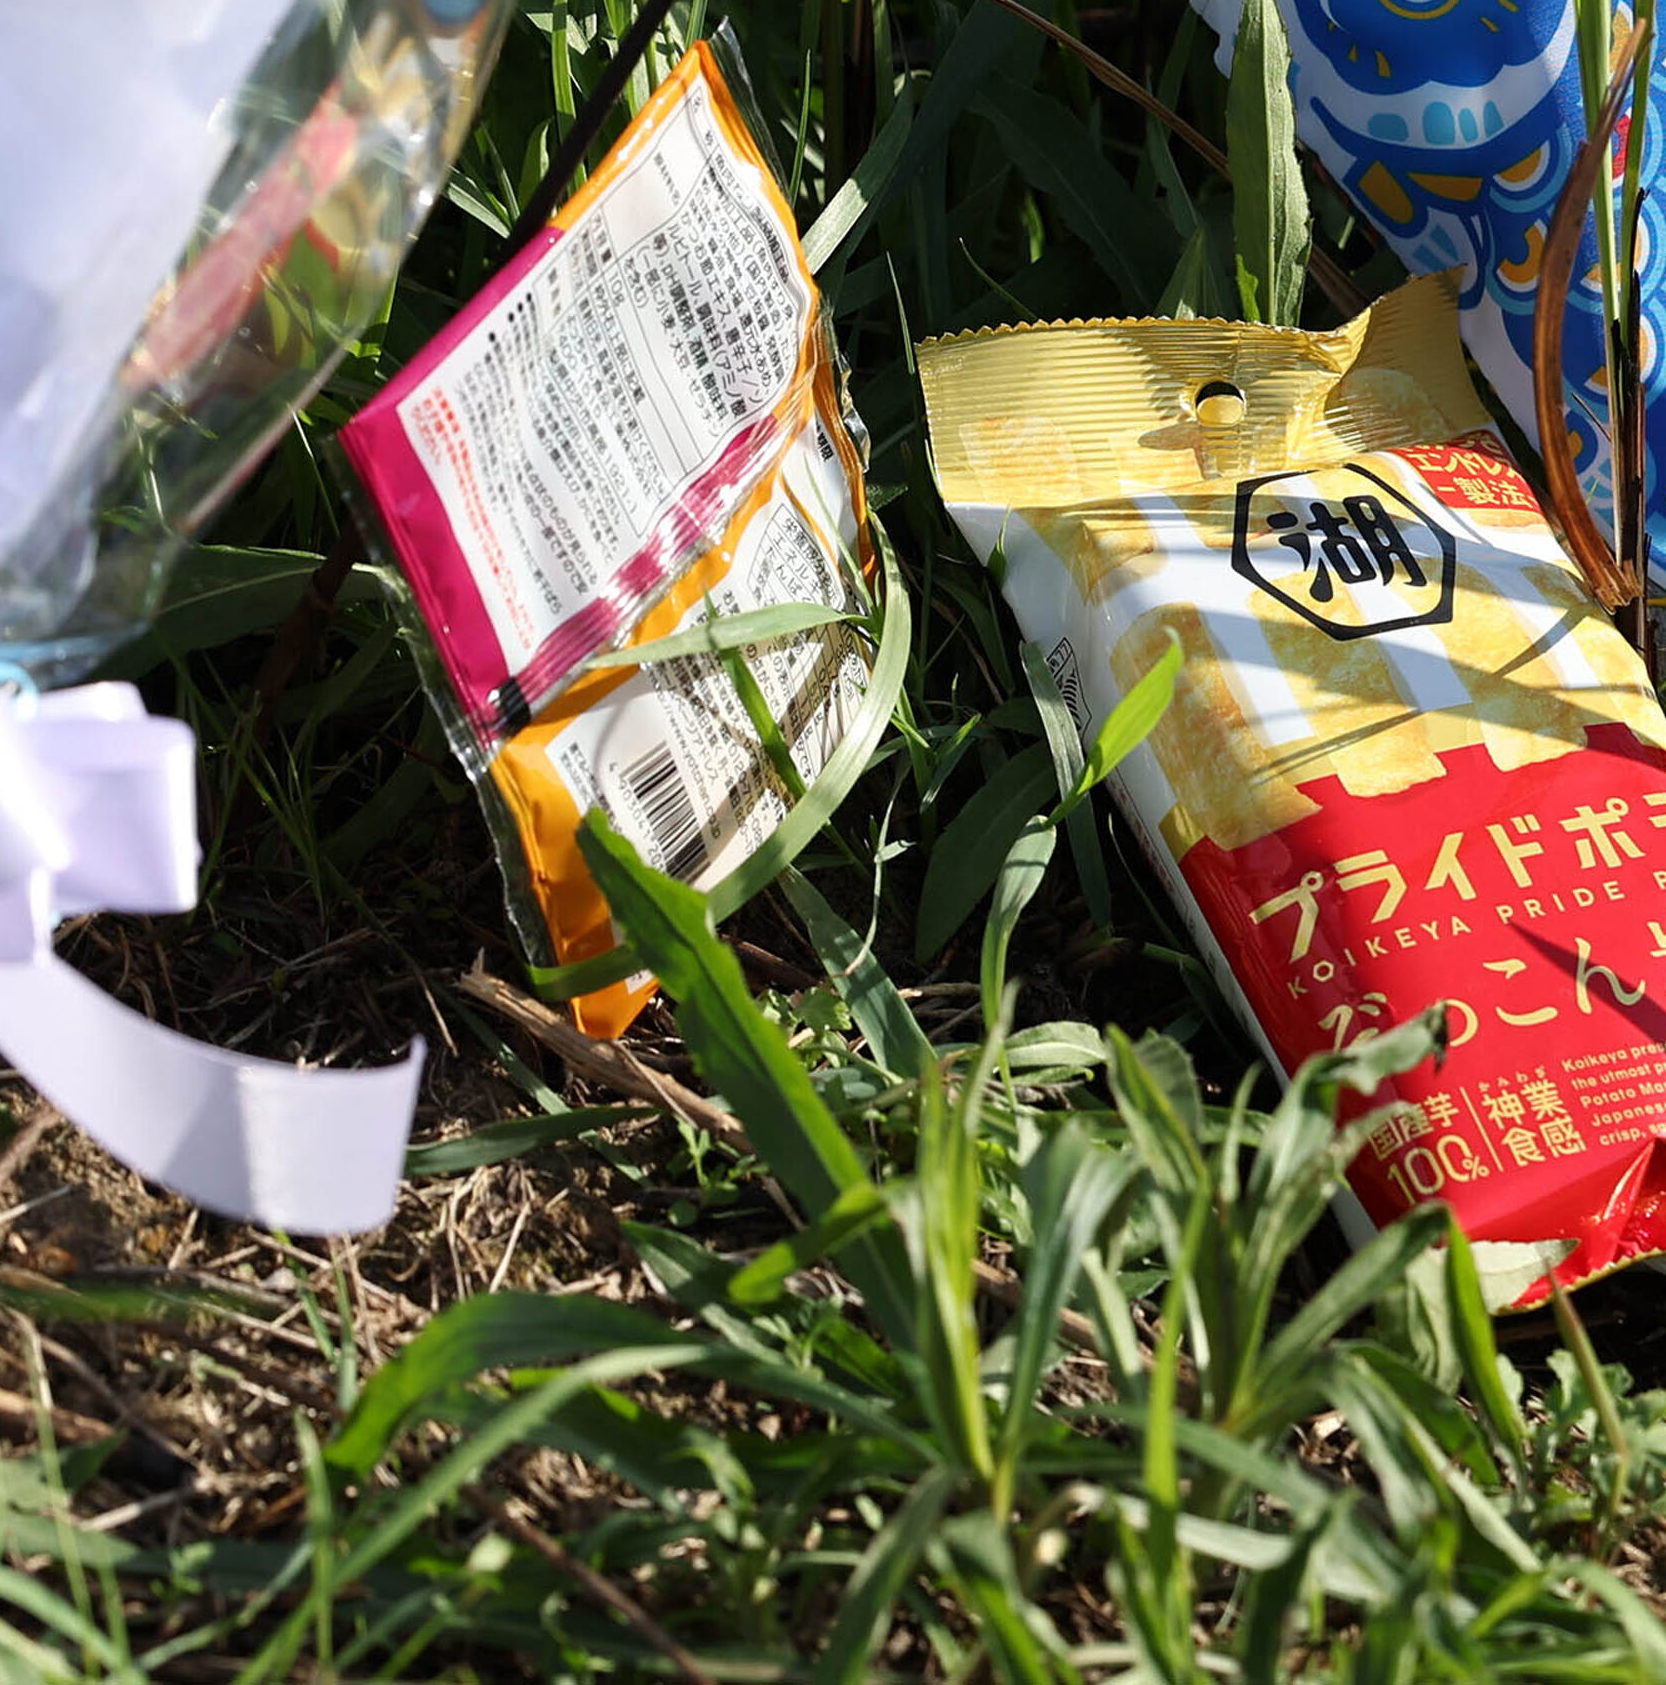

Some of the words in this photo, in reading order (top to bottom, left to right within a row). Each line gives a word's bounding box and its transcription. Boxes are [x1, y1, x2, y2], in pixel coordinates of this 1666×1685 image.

[607, 272, 626, 305] 10g
[1266, 495, 1427, 603] 湖
[1288, 916, 1472, 1001] KOIKEYA
[1495, 880, 1626, 925] PRIDE
[1562, 1048, 1627, 1073] Koikeya
[1572, 1074, 1598, 1091] the
[1600, 1064, 1651, 1085] utmost
[1580, 1088, 1636, 1109] Potato
[1387, 1132, 1490, 1206] 100%
[1480, 1081, 1565, 1131] 神業
[1503, 1116, 1588, 1170] 食感
[1600, 1124, 1647, 1148] crisp,
